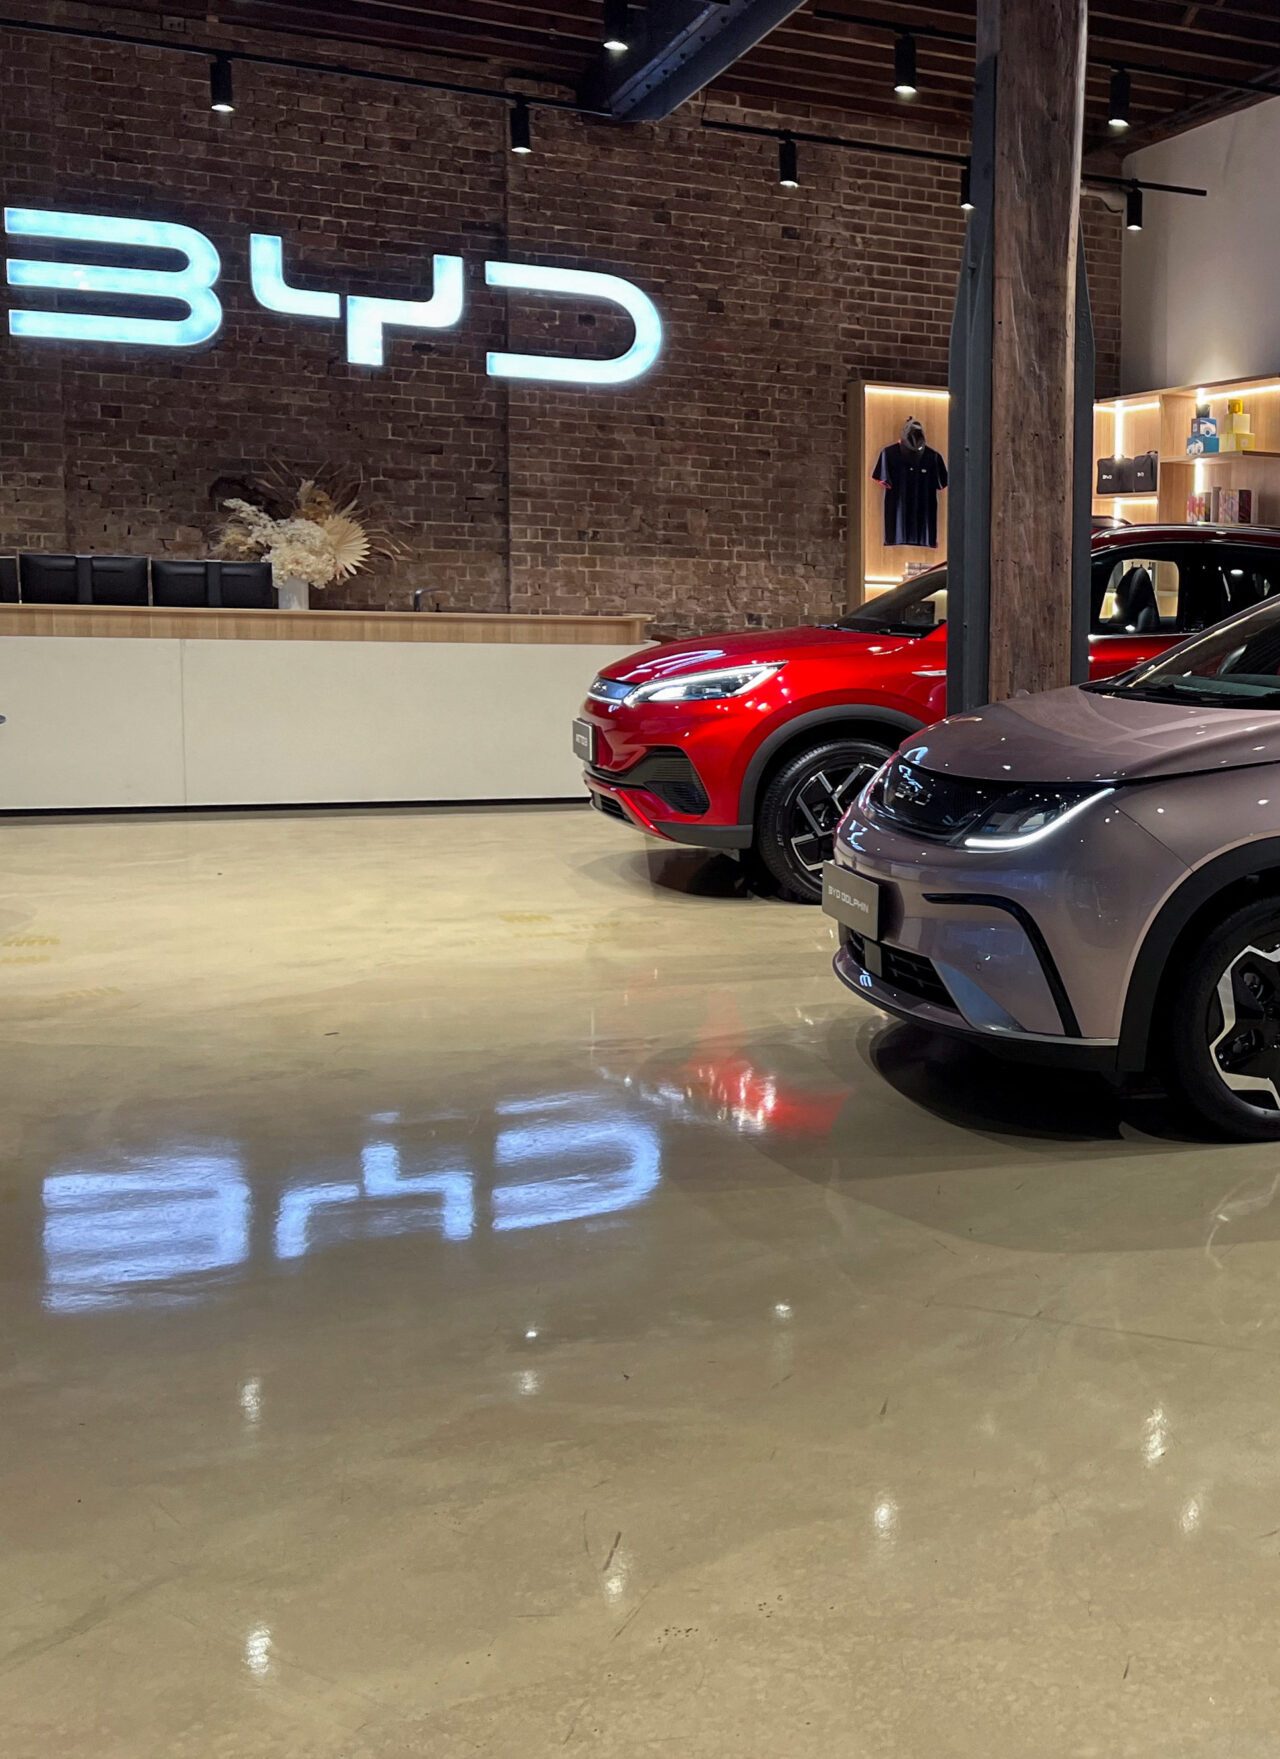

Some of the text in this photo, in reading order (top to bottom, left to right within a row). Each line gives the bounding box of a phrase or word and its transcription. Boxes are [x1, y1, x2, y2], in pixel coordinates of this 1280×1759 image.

[4, 206, 664, 384] BYD
[827, 885, 870, 914] BYD DOLPHIN
